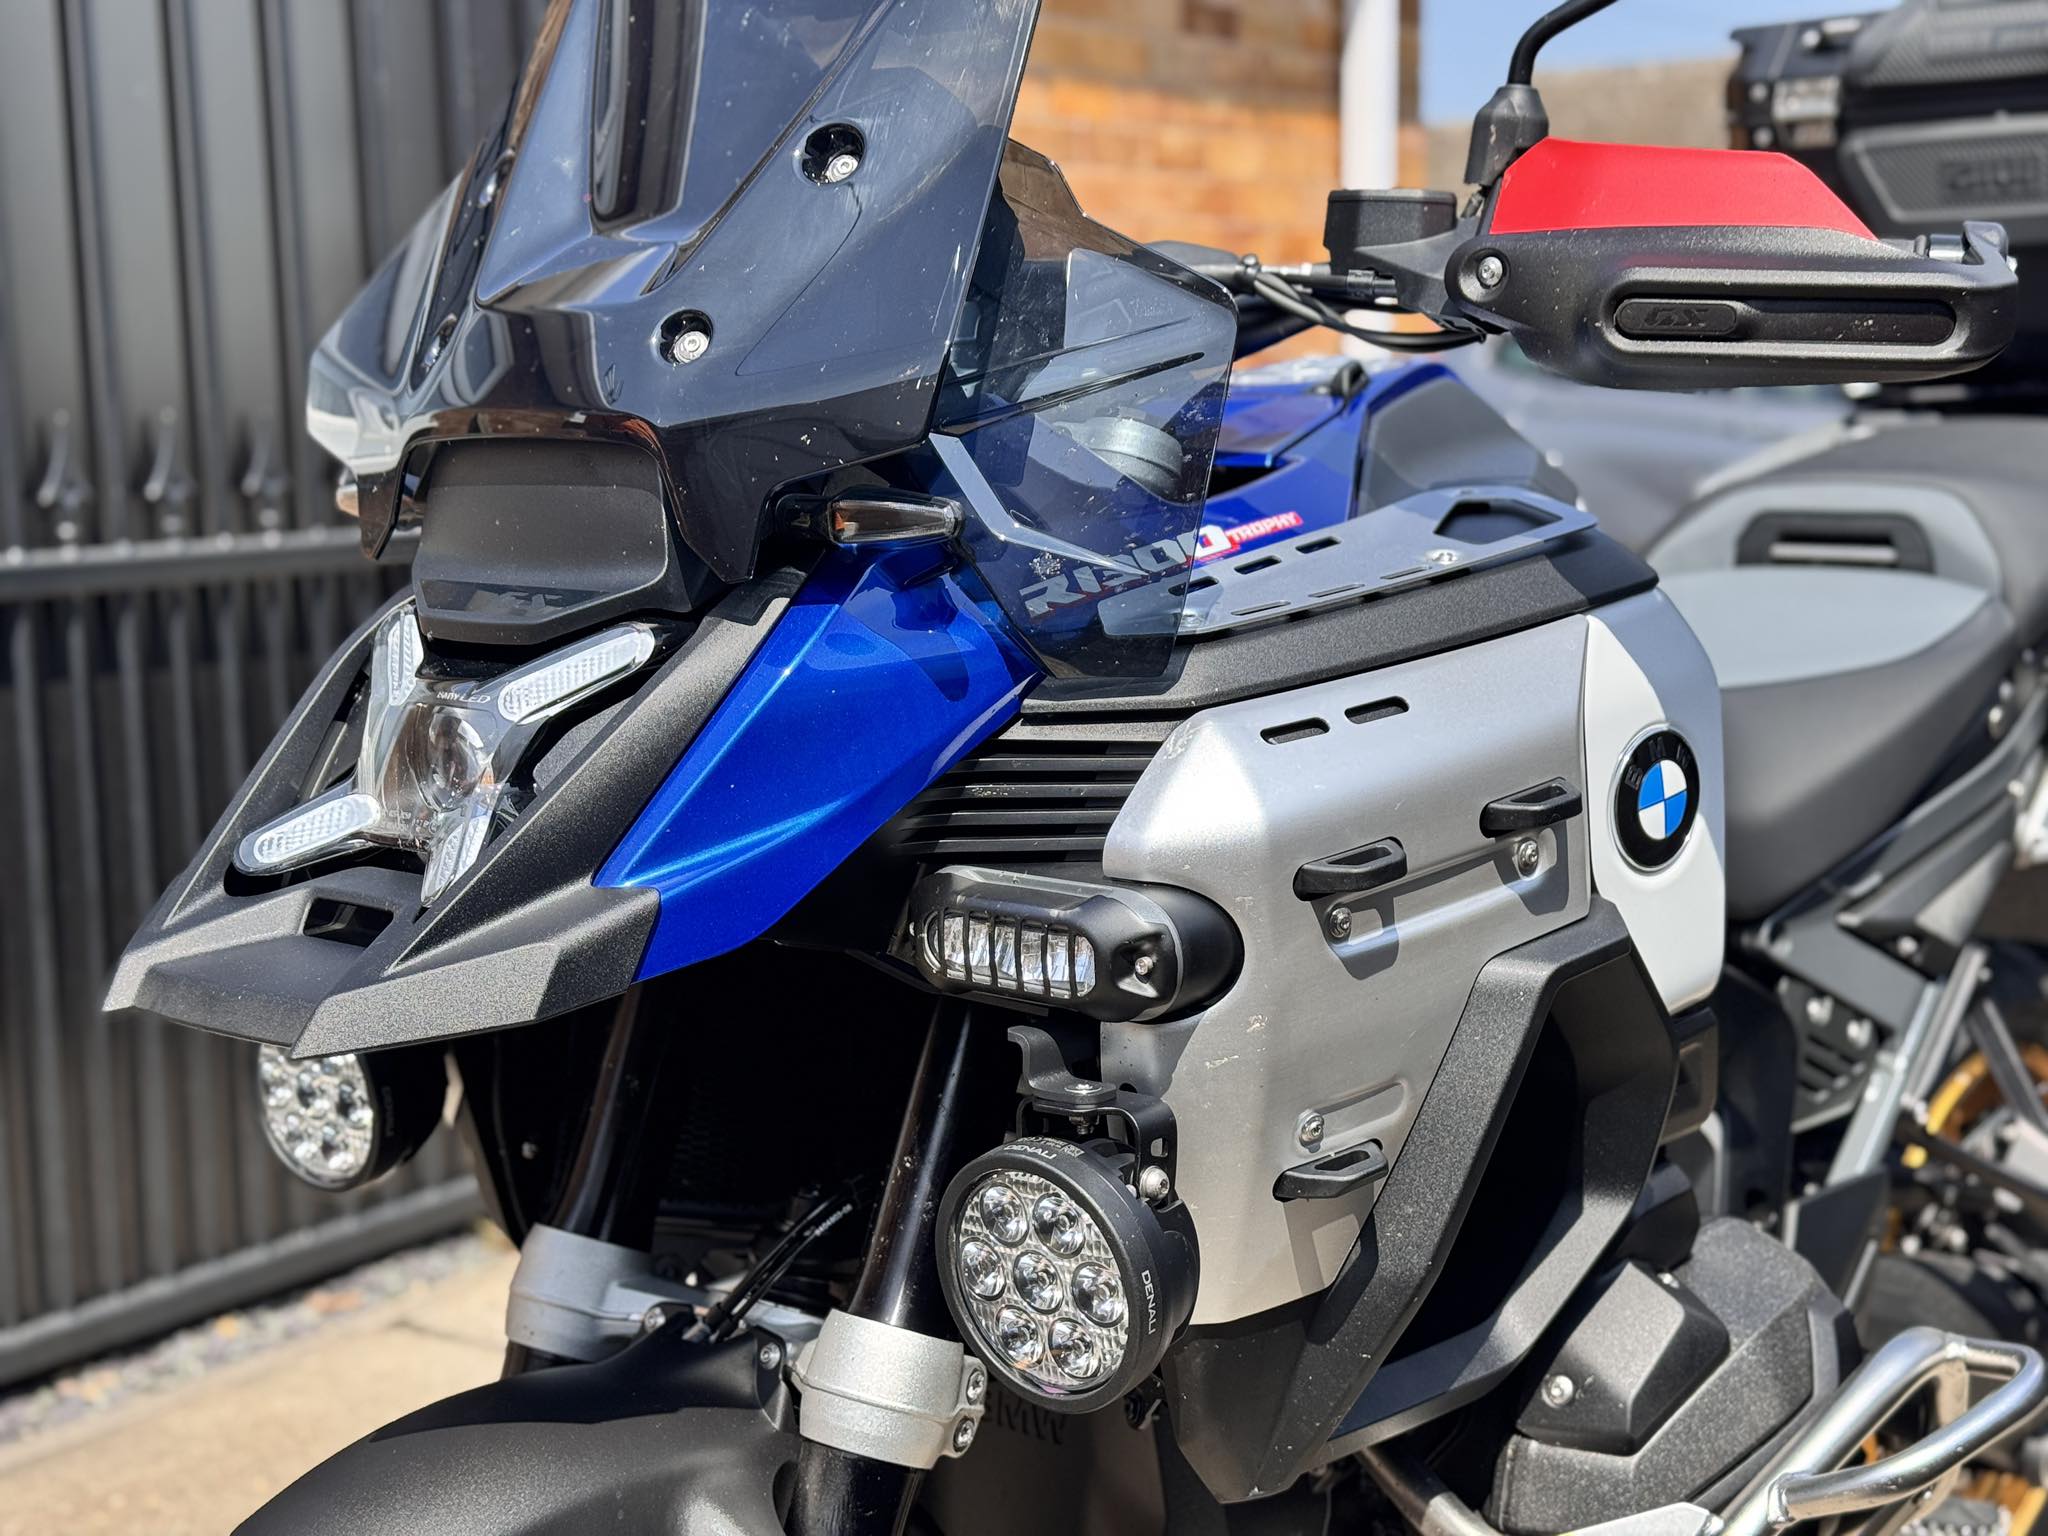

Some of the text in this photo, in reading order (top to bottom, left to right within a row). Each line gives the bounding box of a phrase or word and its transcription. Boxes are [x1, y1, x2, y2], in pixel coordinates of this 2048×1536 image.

[1226, 511, 1300, 542] TROPHY
[1624, 736, 1692, 791] BMW
[1003, 1144, 1057, 1160] DENALI
[1141, 1269, 1157, 1335] DENALI
